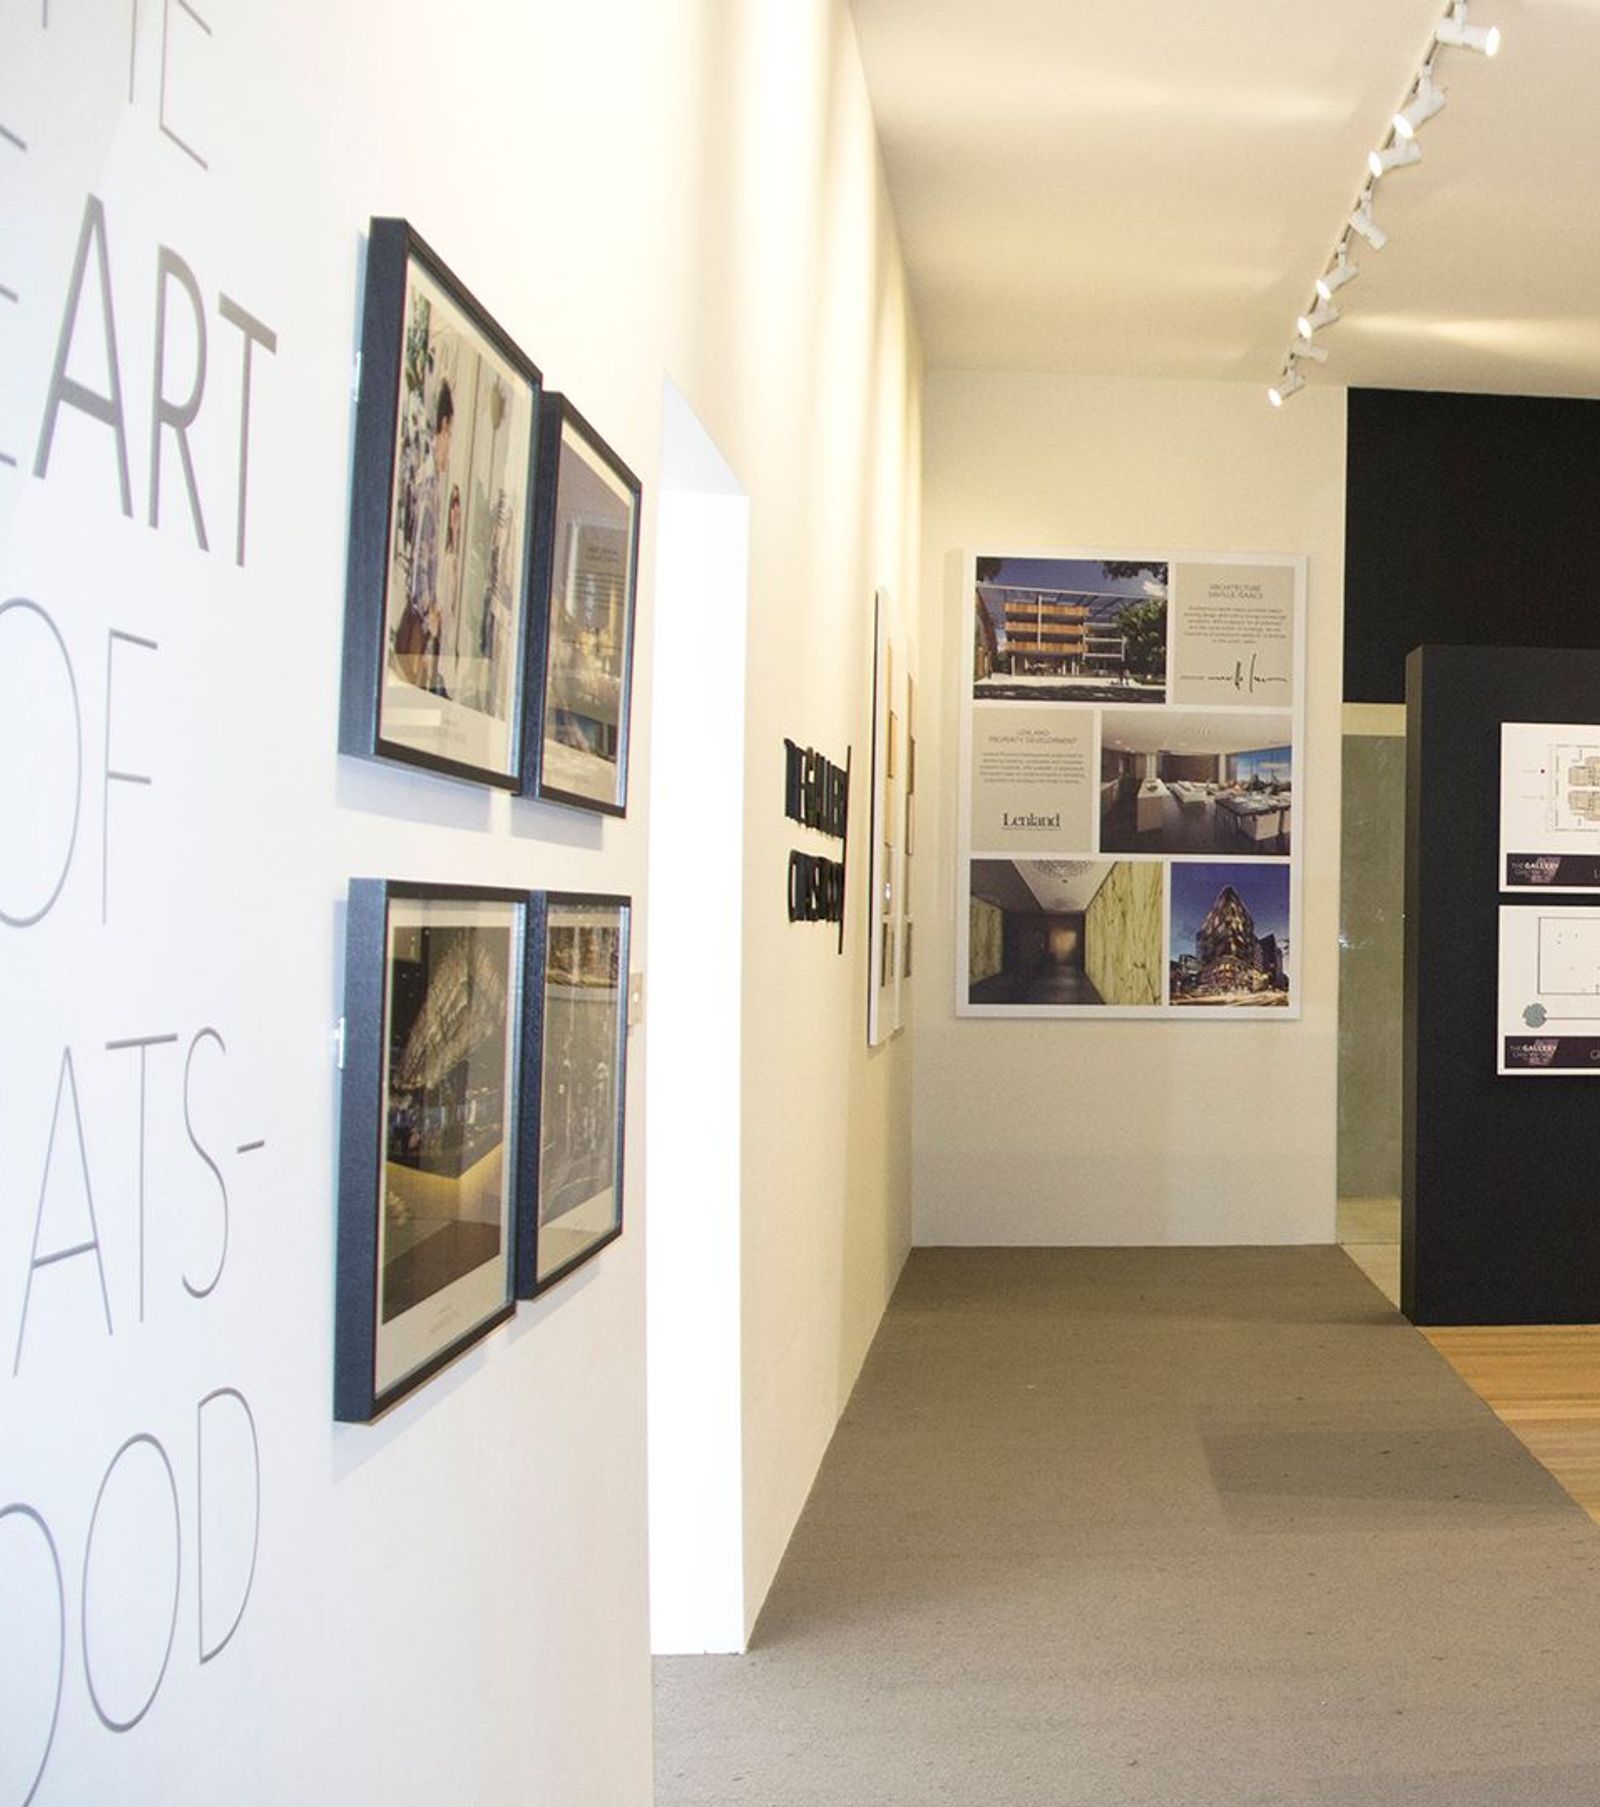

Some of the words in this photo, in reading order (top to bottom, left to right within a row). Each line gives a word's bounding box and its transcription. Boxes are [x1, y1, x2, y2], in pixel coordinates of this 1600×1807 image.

[0, 126, 277, 567] ART
[0, 597, 158, 926] OF
[1003, 812, 1060, 827] Lenland
